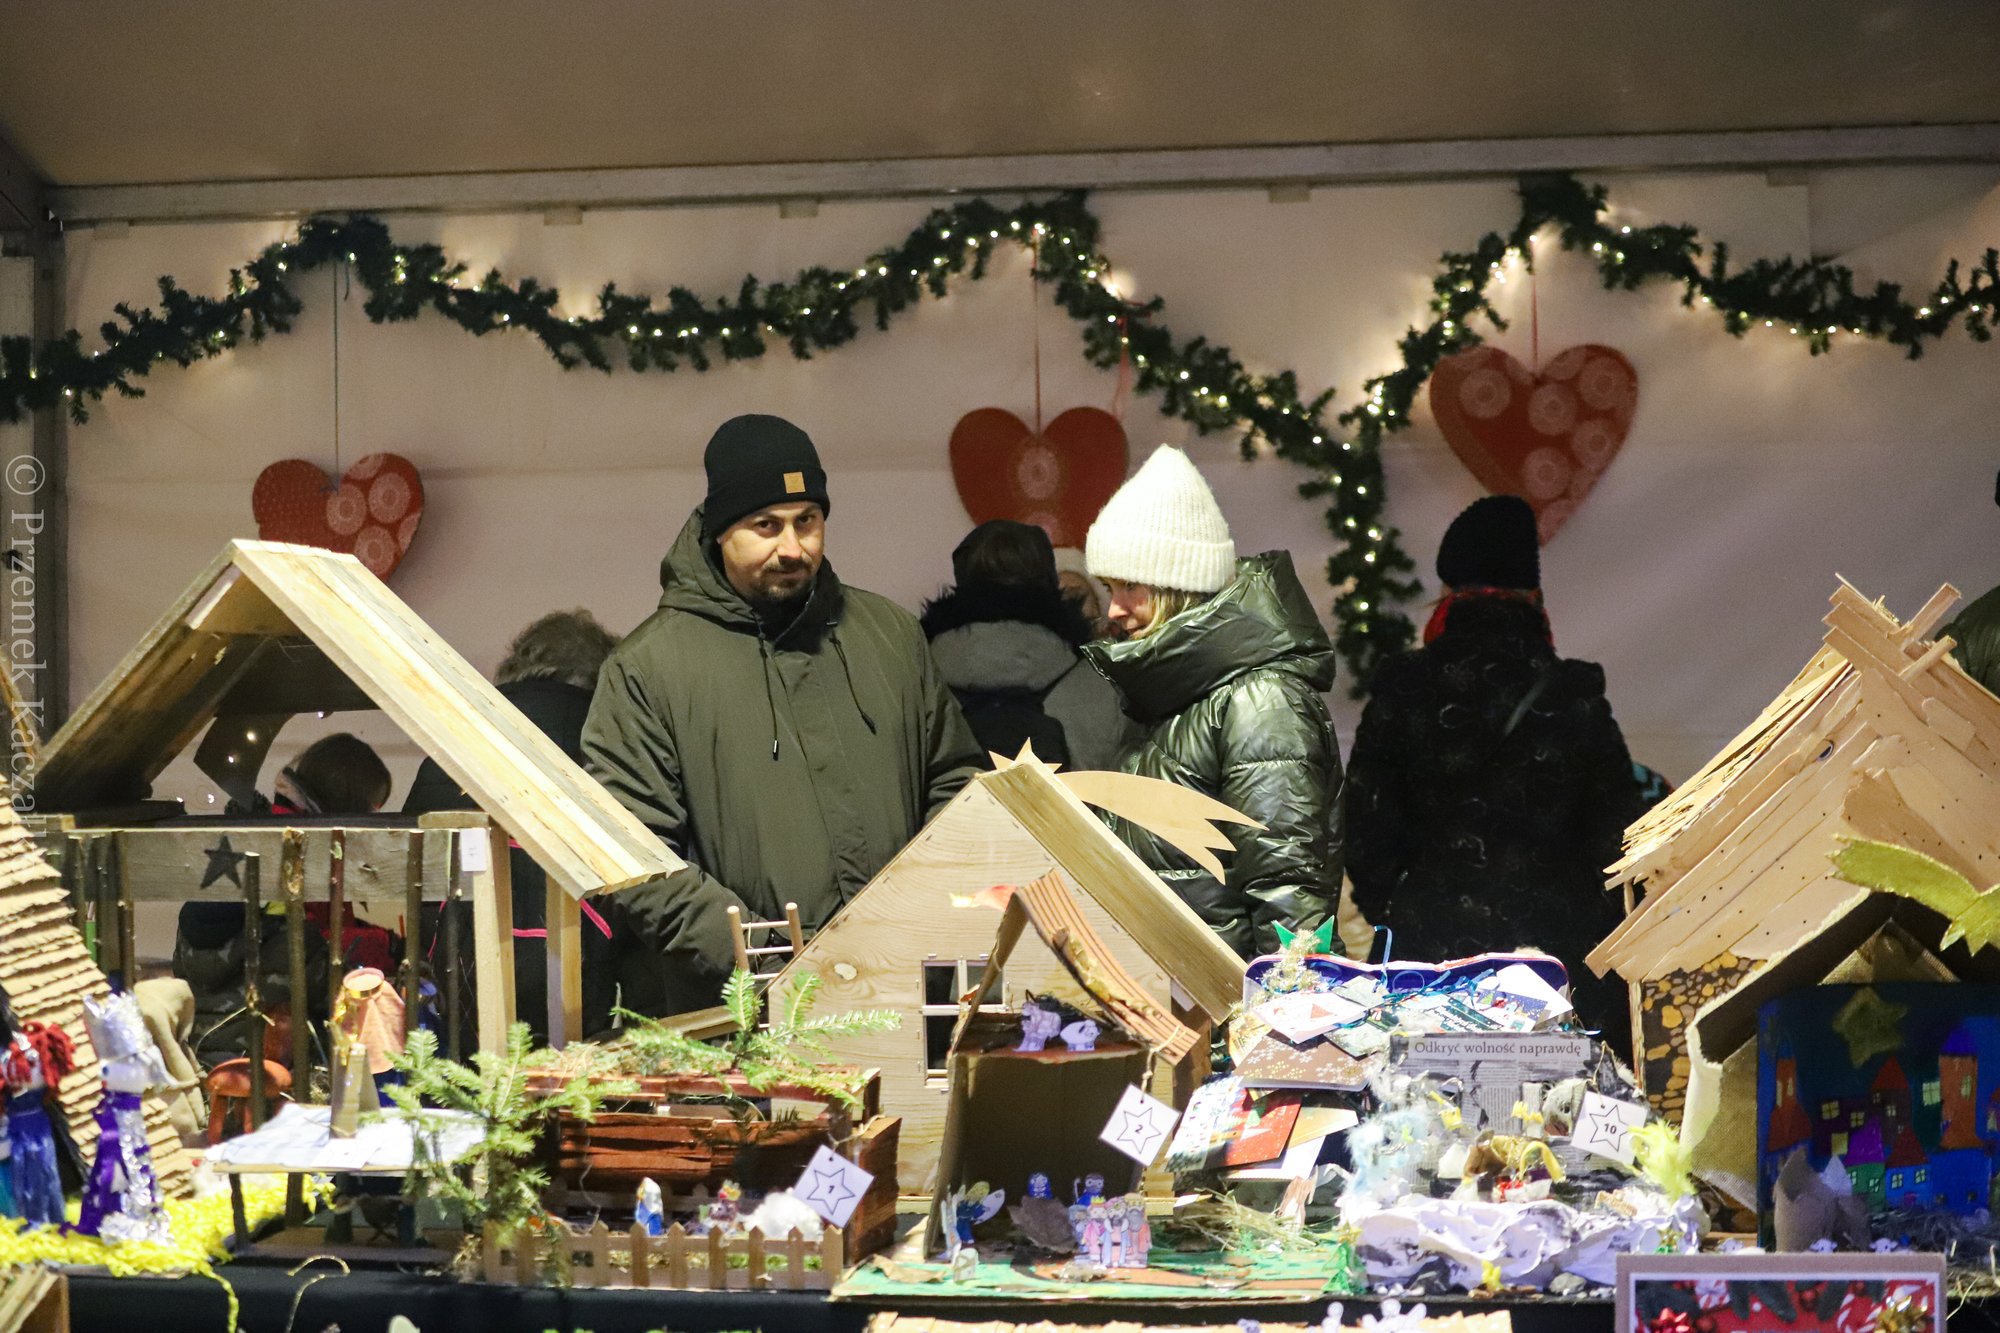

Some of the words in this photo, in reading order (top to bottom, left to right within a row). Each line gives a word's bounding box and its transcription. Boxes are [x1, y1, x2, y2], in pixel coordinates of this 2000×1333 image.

[1414, 1041, 1461, 1059] Odkryć
[1464, 1041, 1516, 1054] wolność
[1519, 1042, 1582, 1057] naprawdę
[1135, 1124, 1143, 1134] 2
[1604, 1123, 1617, 1135] 10
[828, 1185, 835, 1194] 1
